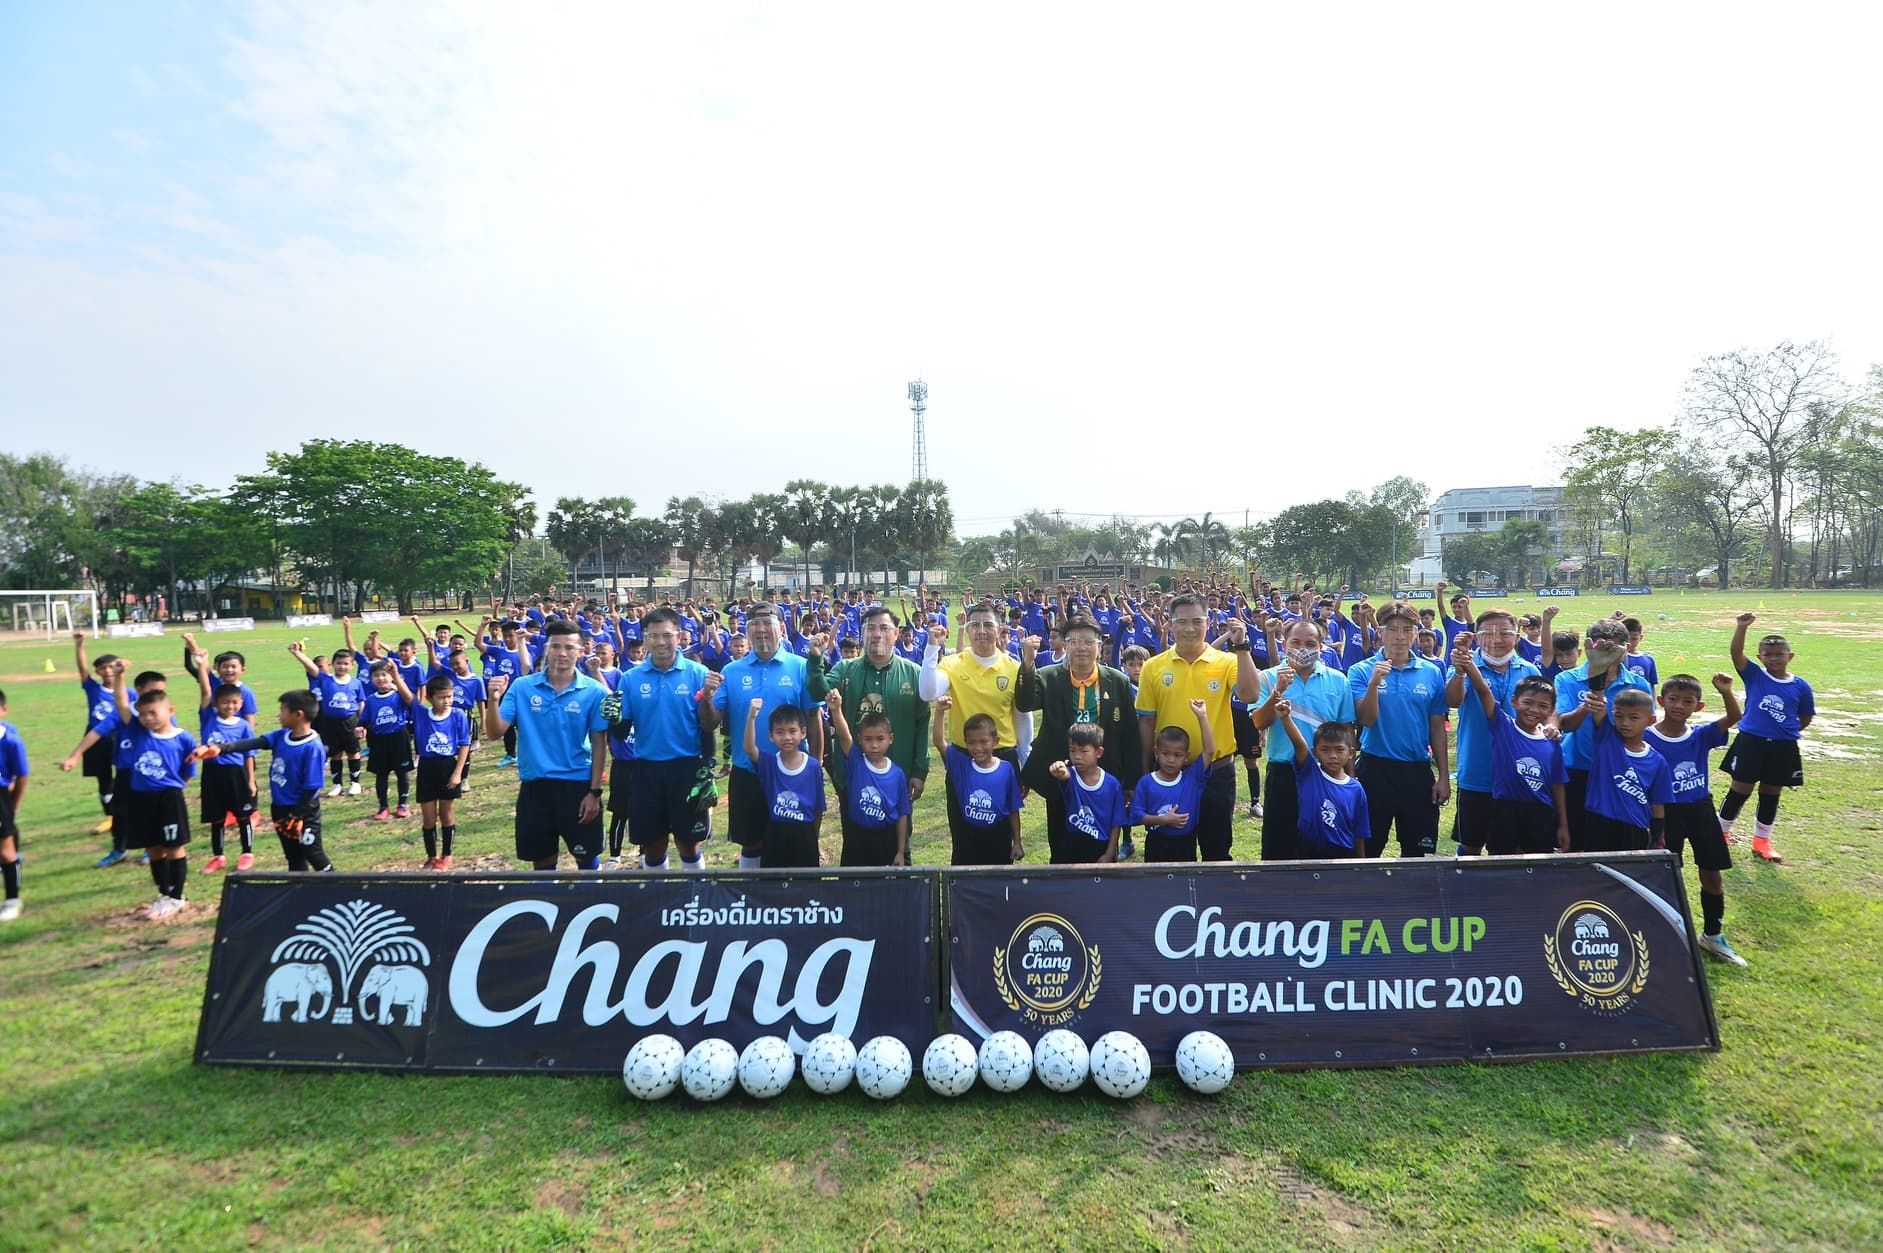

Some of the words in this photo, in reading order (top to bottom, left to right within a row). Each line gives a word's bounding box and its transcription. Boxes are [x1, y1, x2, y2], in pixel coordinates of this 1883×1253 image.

[1407, 590, 1432, 599] Chang
[1551, 588, 1576, 598] Chang
[1076, 710, 1090, 723] 23
[1613, 774, 1648, 805] Chang
[964, 805, 997, 825] Chang
[162, 823, 179, 841] 17
[661, 895, 844, 926] เครื่องดื่มตราช้าง
[1154, 904, 1331, 969] Chang
[1340, 919, 1392, 956] FA
[1401, 915, 1487, 955] CUP
[1571, 939, 1619, 957] Chang
[1021, 953, 1072, 972] Chang
[1578, 960, 1594, 971] FA
[1595, 959, 1619, 970] CUP
[448, 899, 877, 1056] Chang
[1026, 973, 1042, 985] FA
[1044, 973, 1069, 985] CUP
[1587, 972, 1616, 983] 2020
[1034, 986, 1063, 998] 2020
[1131, 981, 1317, 1016] FOOTBALL
[1323, 978, 1438, 1012] CLINIC
[1445, 975, 1523, 1008] 2020
[1581, 993, 1596, 1006] 50
[1598, 992, 1631, 1010] YEARS
[1023, 1007, 1038, 1021] 50
[1040, 1007, 1075, 1025] YEARS
